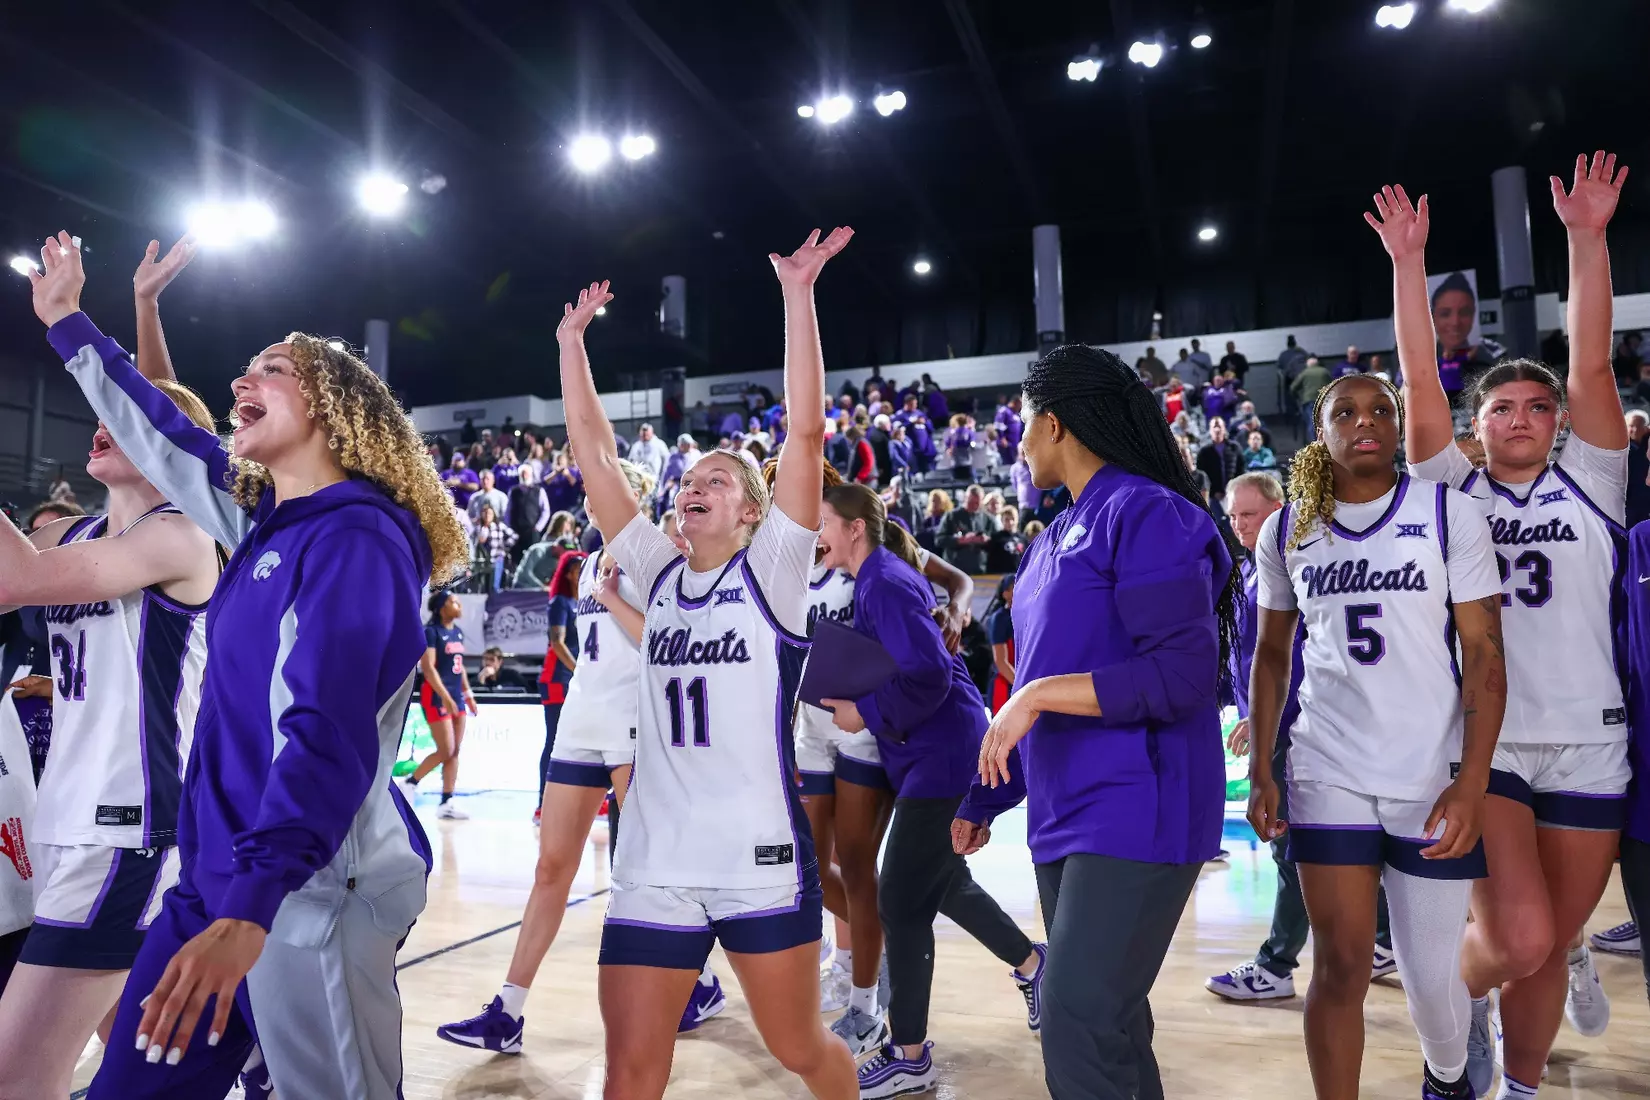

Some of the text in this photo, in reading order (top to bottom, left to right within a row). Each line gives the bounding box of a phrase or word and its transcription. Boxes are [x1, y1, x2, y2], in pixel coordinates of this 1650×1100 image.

[1302, 558, 1428, 599] Wildcats
[584, 621, 599, 661] 4
[1345, 603, 1386, 665] 5
[665, 676, 711, 747] 11
[126, 811, 136, 820] M
